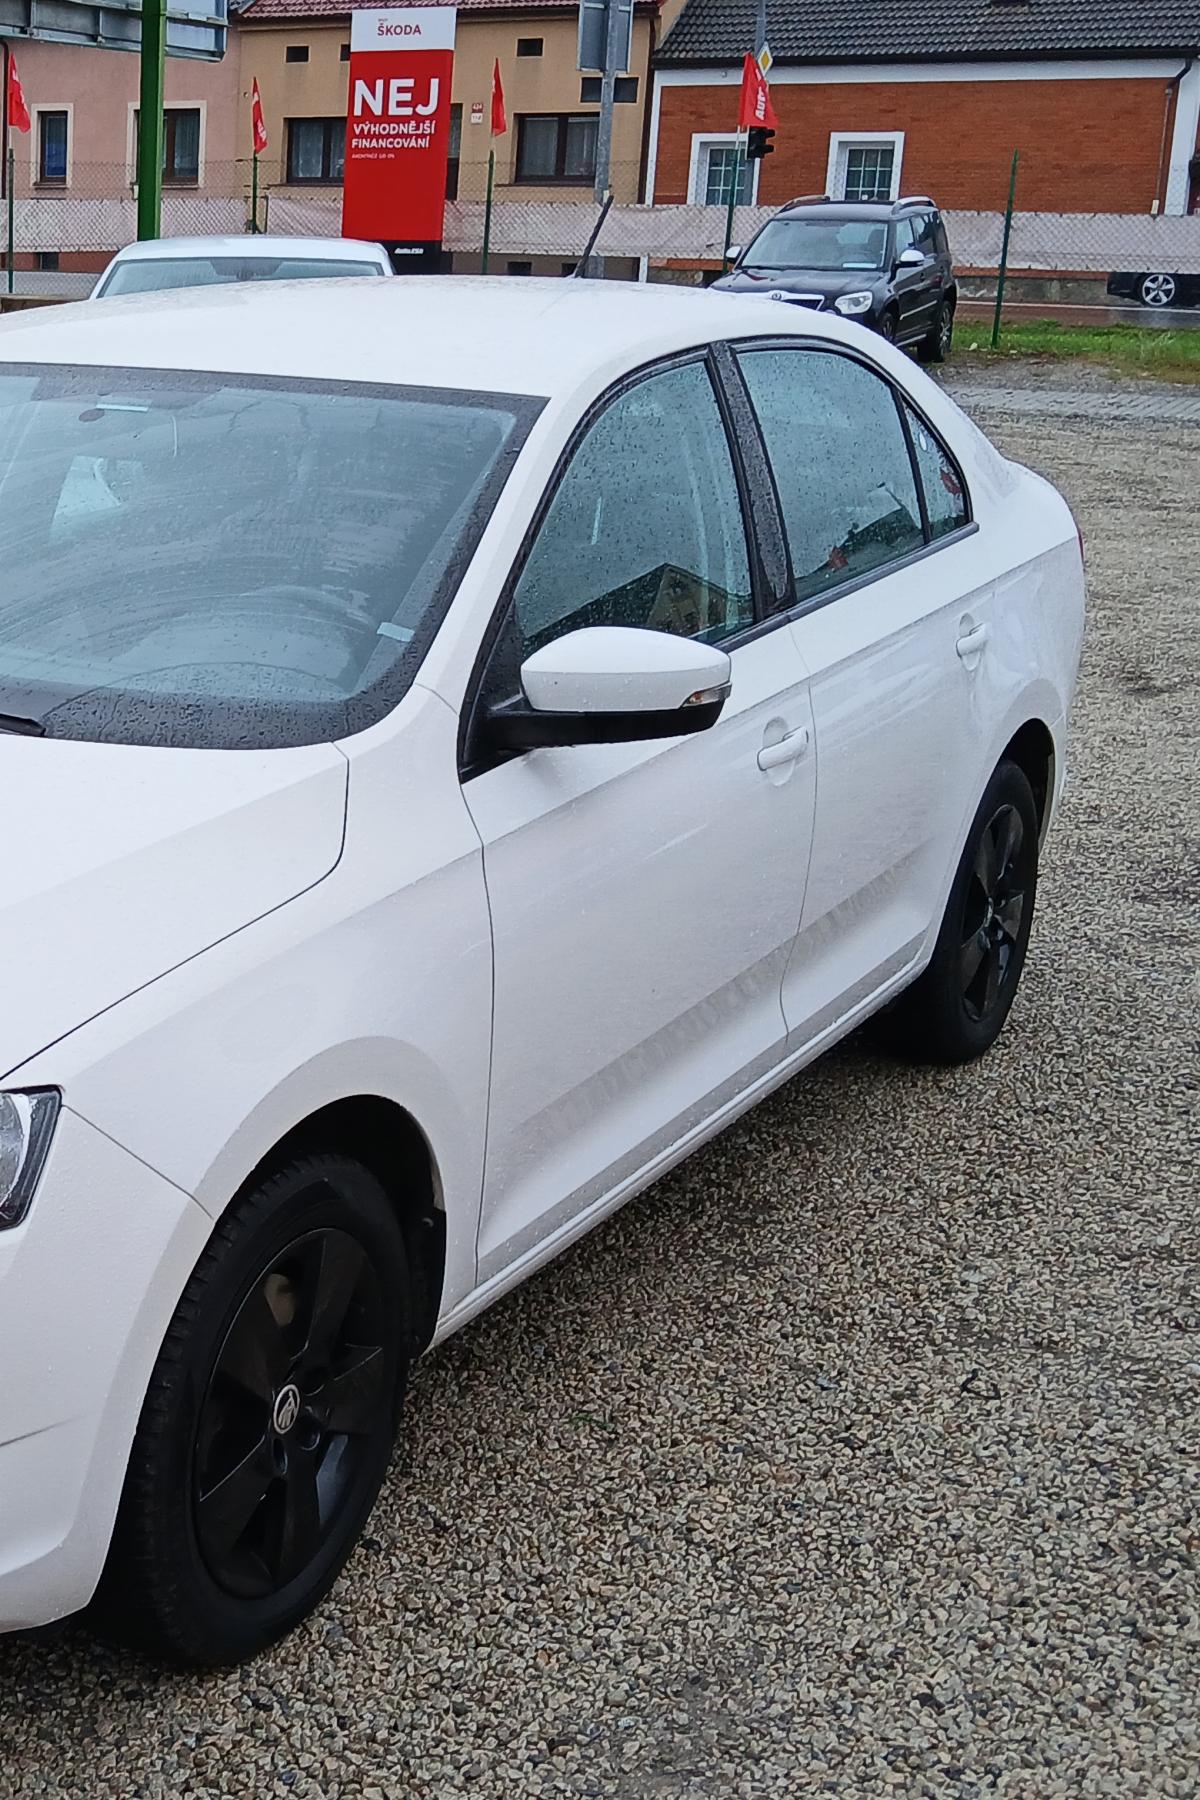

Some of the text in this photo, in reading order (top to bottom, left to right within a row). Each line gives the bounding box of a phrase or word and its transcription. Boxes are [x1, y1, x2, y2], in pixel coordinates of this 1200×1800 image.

[377, 22, 422, 36] ŠKODA
[353, 78, 440, 116] NEJ
[353, 120, 436, 135] VÝHODNĚJŠÍ
[351, 136, 430, 148] FINANCOVÁNÍ
